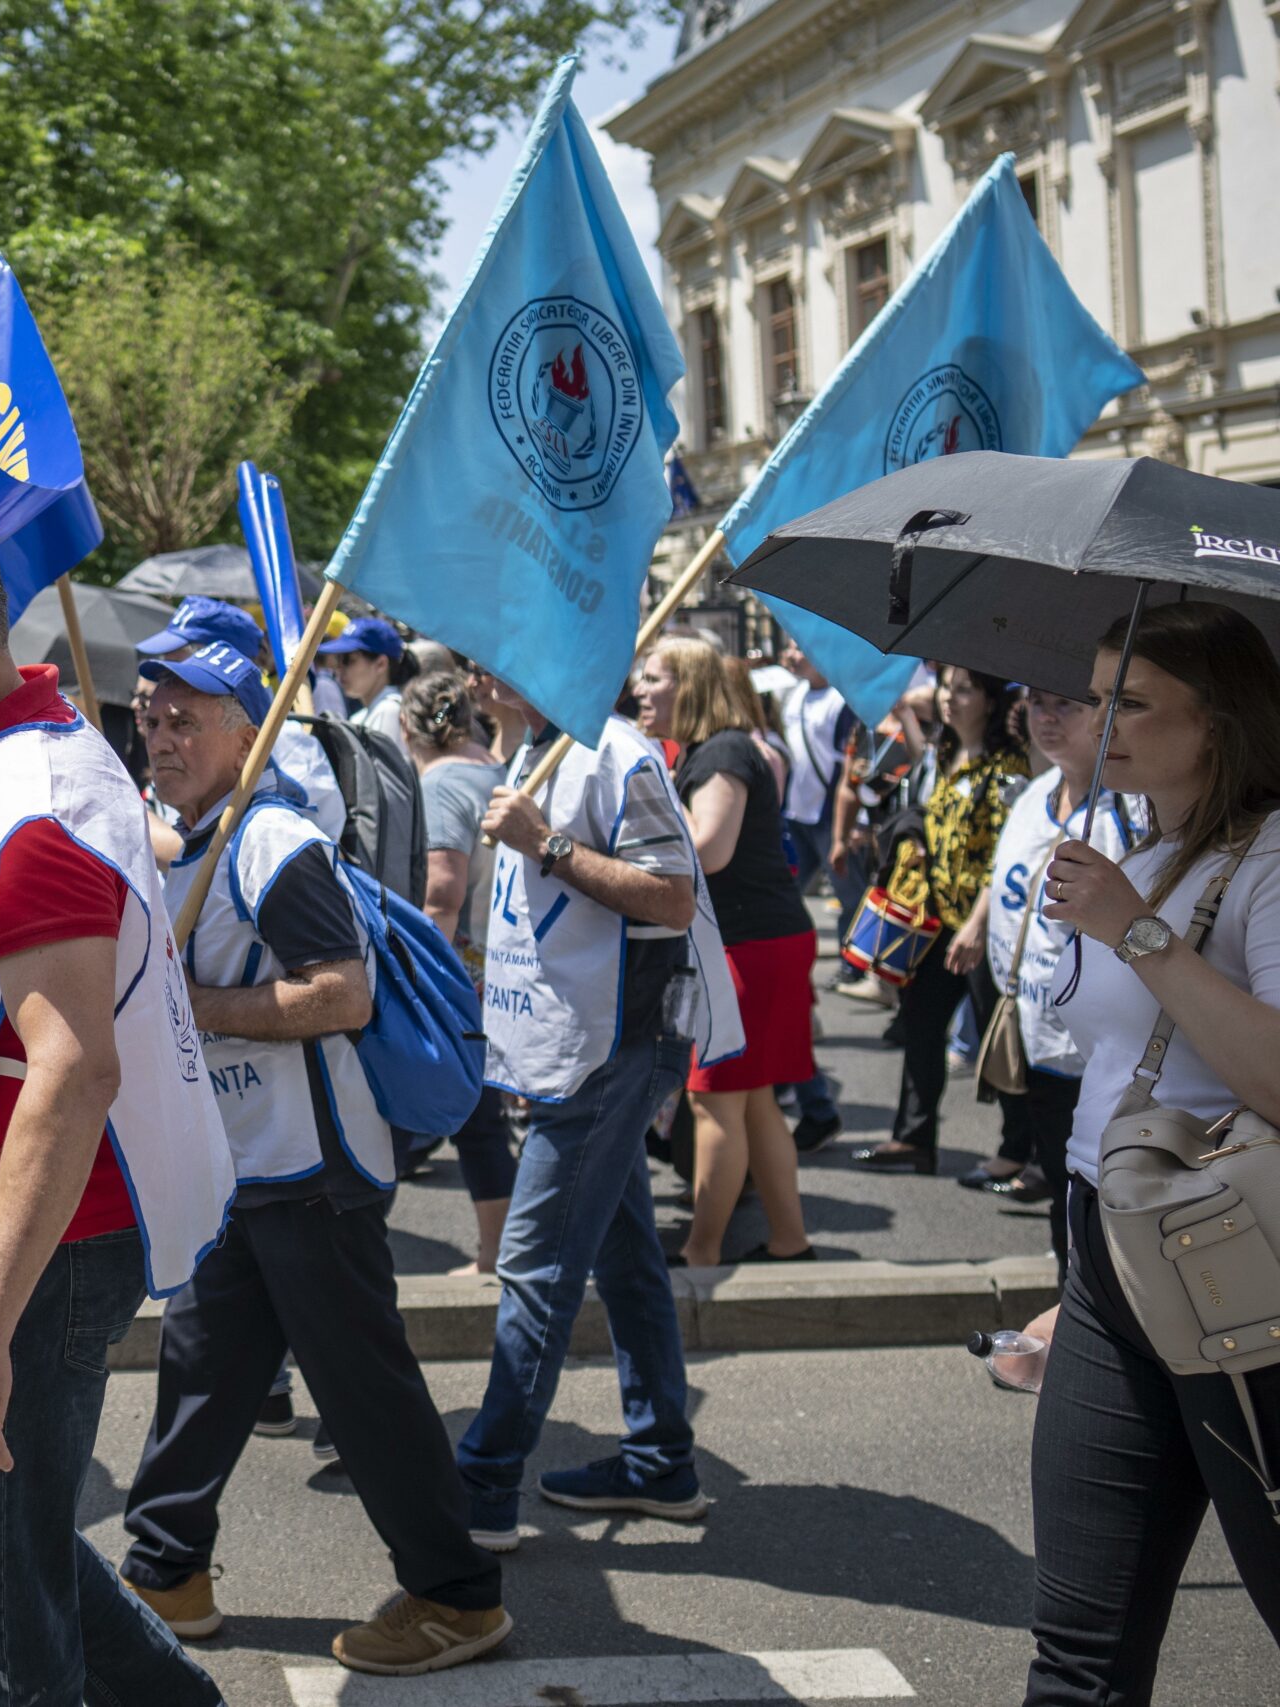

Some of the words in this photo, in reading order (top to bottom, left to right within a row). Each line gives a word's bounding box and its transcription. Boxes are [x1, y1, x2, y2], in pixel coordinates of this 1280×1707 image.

[520, 303, 590, 334] SINDICATEOR
[590, 320, 632, 372] LIBERE
[621, 376, 636, 406] DIN
